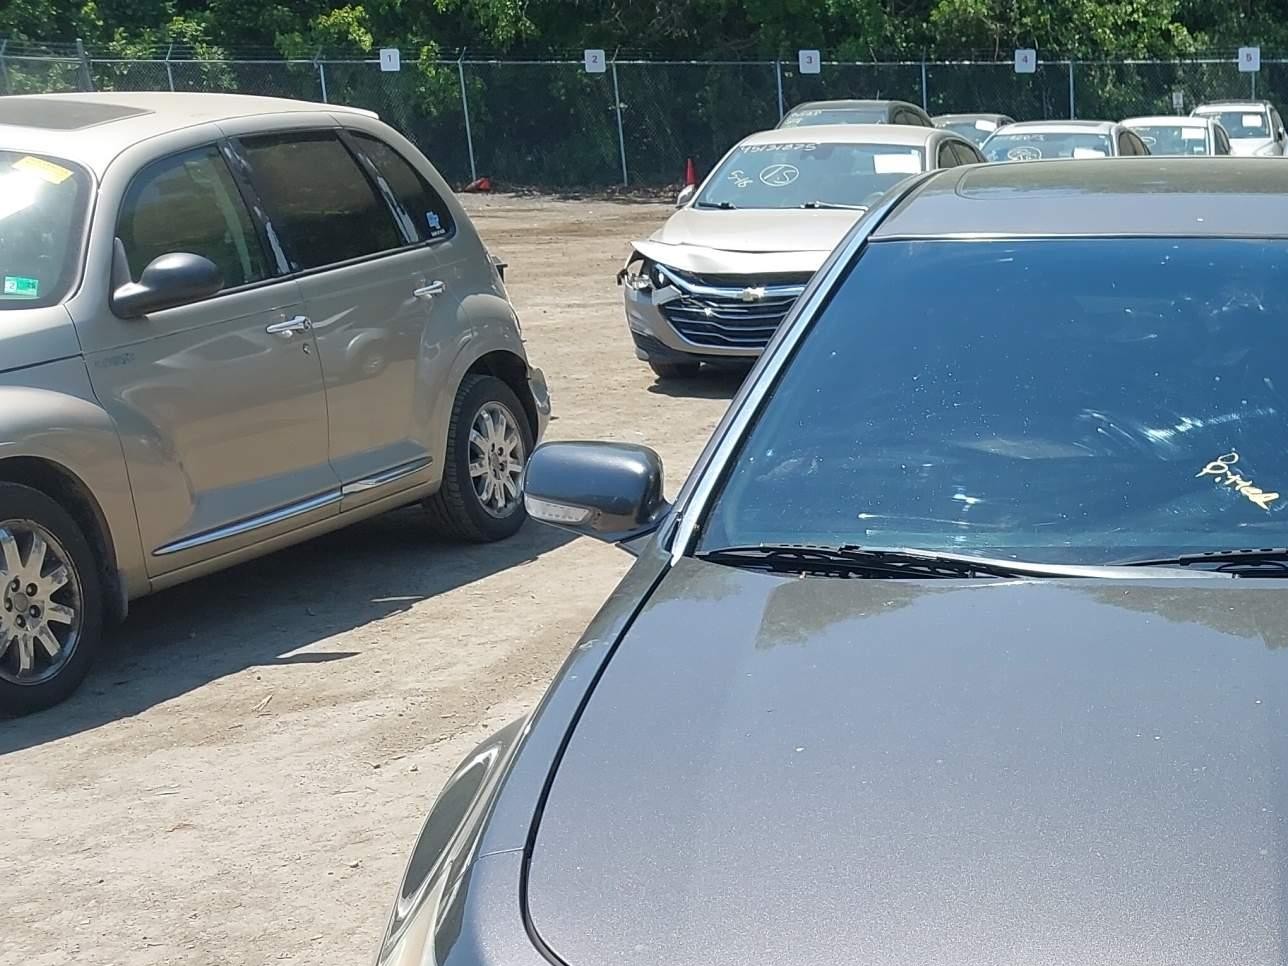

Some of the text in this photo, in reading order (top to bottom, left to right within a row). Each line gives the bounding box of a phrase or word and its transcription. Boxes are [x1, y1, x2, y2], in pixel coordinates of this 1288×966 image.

[591, 55, 599, 64] 2
[806, 55, 813, 64] 3
[1022, 55, 1029, 64] 4
